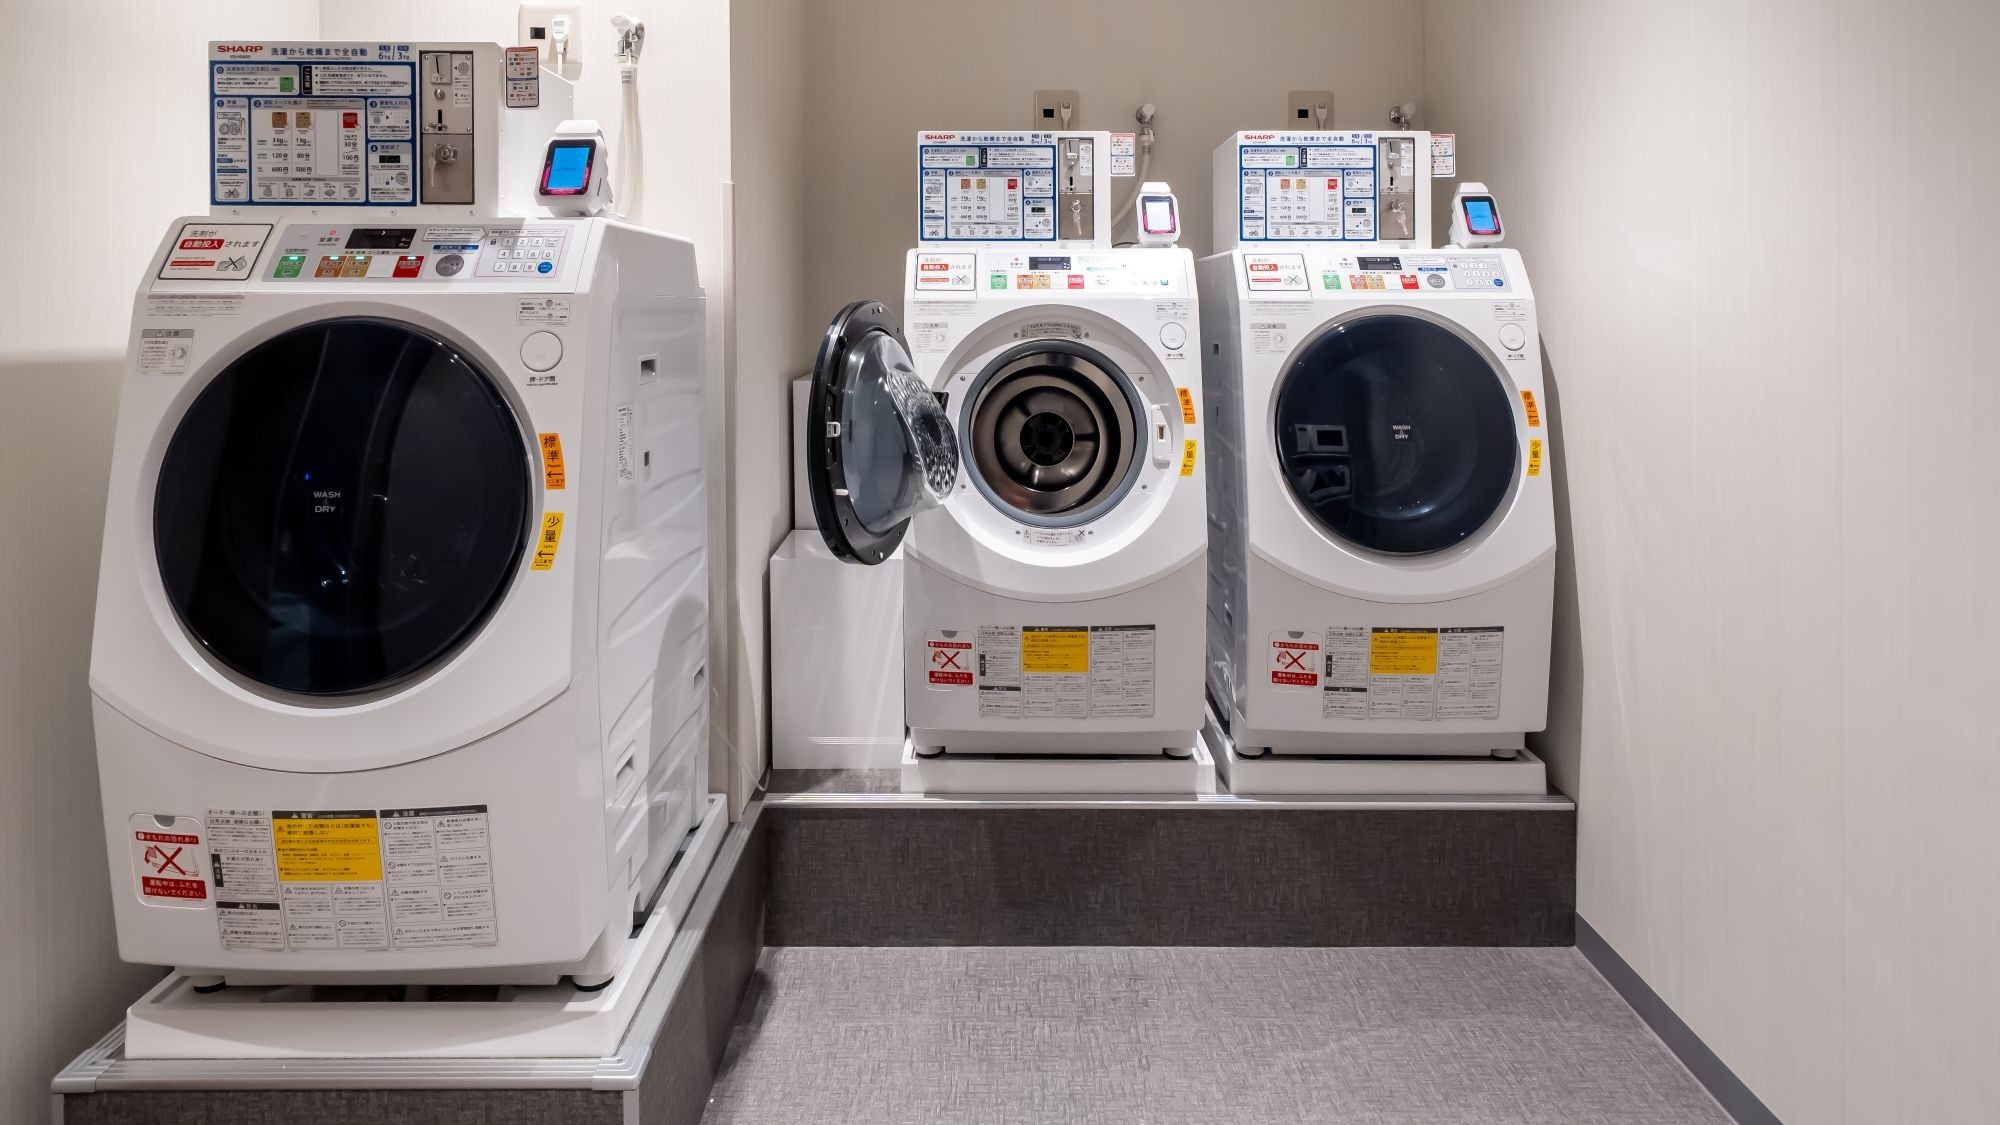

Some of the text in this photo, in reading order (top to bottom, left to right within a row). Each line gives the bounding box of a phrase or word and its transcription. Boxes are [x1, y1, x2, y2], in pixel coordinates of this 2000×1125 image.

[271, 48, 368, 56] 洗濯から乾燥まで全自動
[544, 435, 559, 462] 標準
[544, 516, 560, 542] 少量
[145, 834, 196, 843] 水もれの恐れあり
[150, 880, 198, 888] 運転中は、ふたを
[144, 887, 204, 897] 開けないでください。
